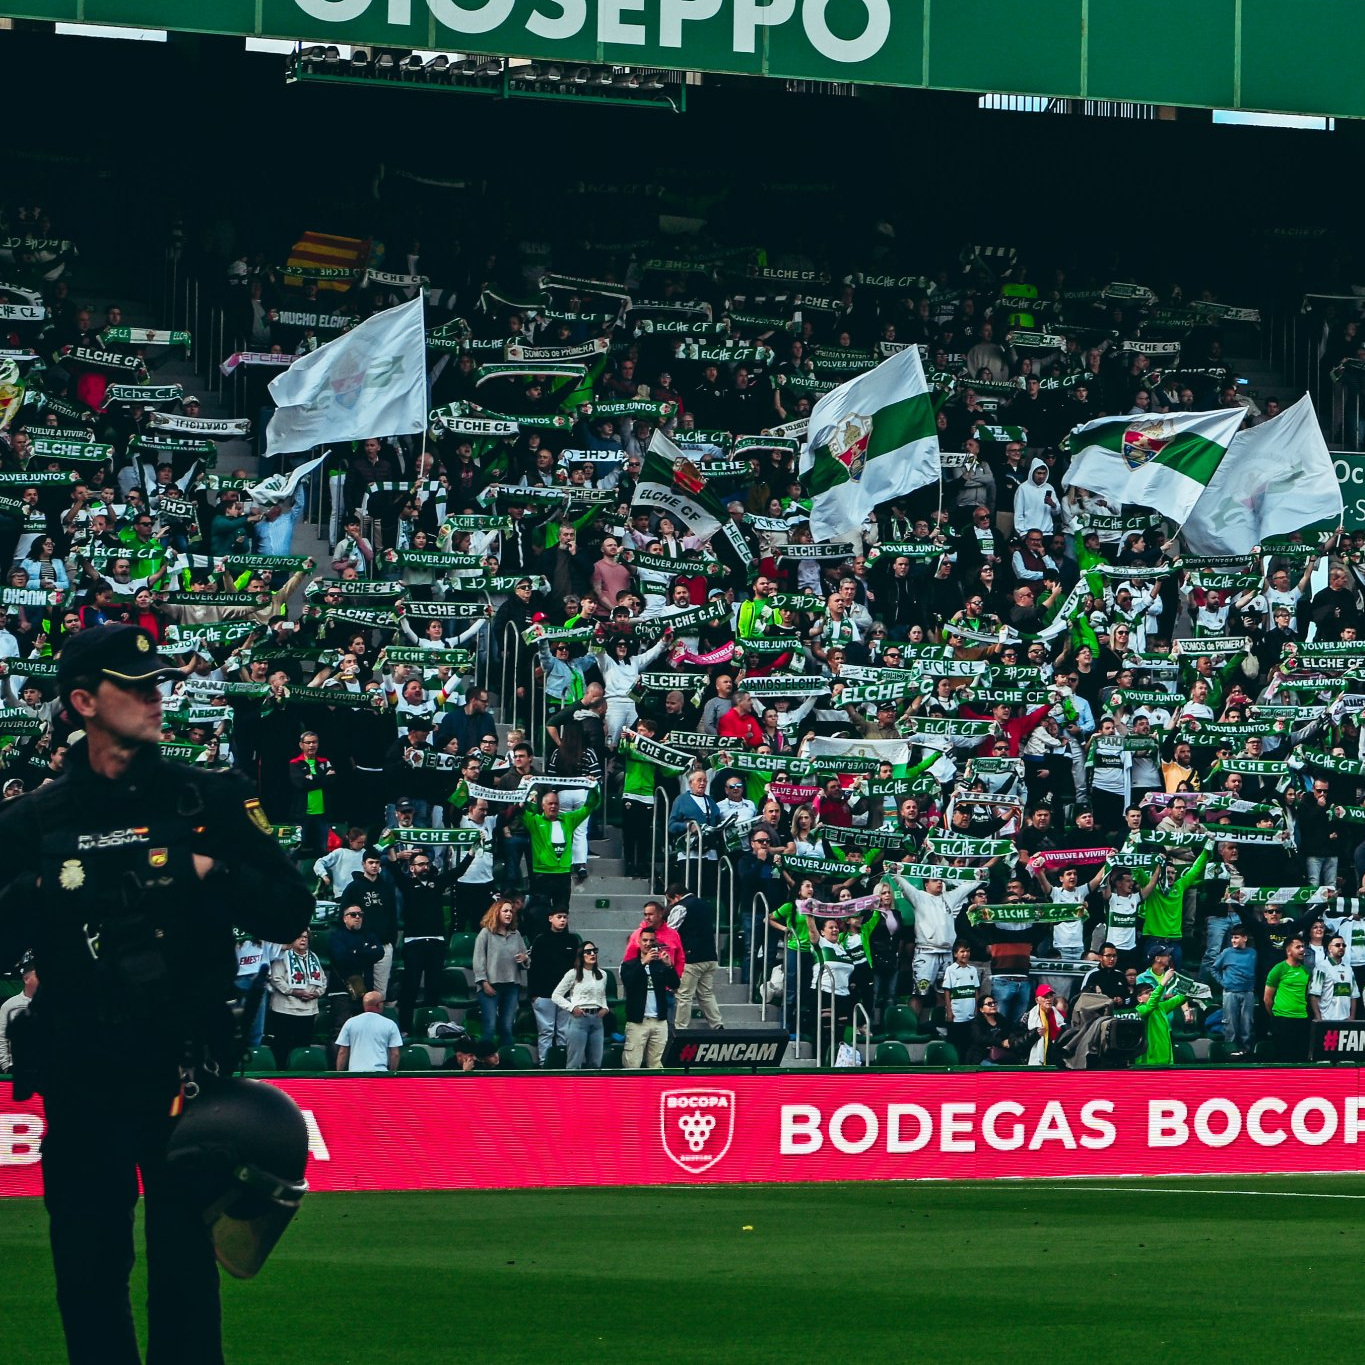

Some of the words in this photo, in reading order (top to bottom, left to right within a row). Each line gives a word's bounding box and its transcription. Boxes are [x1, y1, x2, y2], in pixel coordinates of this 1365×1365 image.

[77, 348, 123, 364] ELCHE
[35, 441, 81, 456] ELCHE
[84, 446, 103, 457] CF
[228, 556, 261, 565] VOLVER
[262, 557, 300, 566] JUNTOS
[403, 553, 439, 563] VOLVER
[441, 554, 476, 564] JUNTOS
[639, 555, 672, 568] VOLVER
[673, 561, 704, 571] JUNTOS
[410, 604, 455, 615] ELCHE
[458, 605, 477, 616] CF
[391, 651, 425, 661] ELCHE
[1302, 658, 1340, 668] ELCHE
[1343, 658, 1364, 668] CF
[977, 689, 1023, 701] ELCHE
[1027, 691, 1045, 702] CF
[738, 756, 786, 769] ELCHE
[790, 761, 809, 771] CF
[681, 1042, 776, 1062] #FANCAM
[668, 1096, 728, 1109] BOCOPA
[781, 1100, 1116, 1154] BODEGAS
